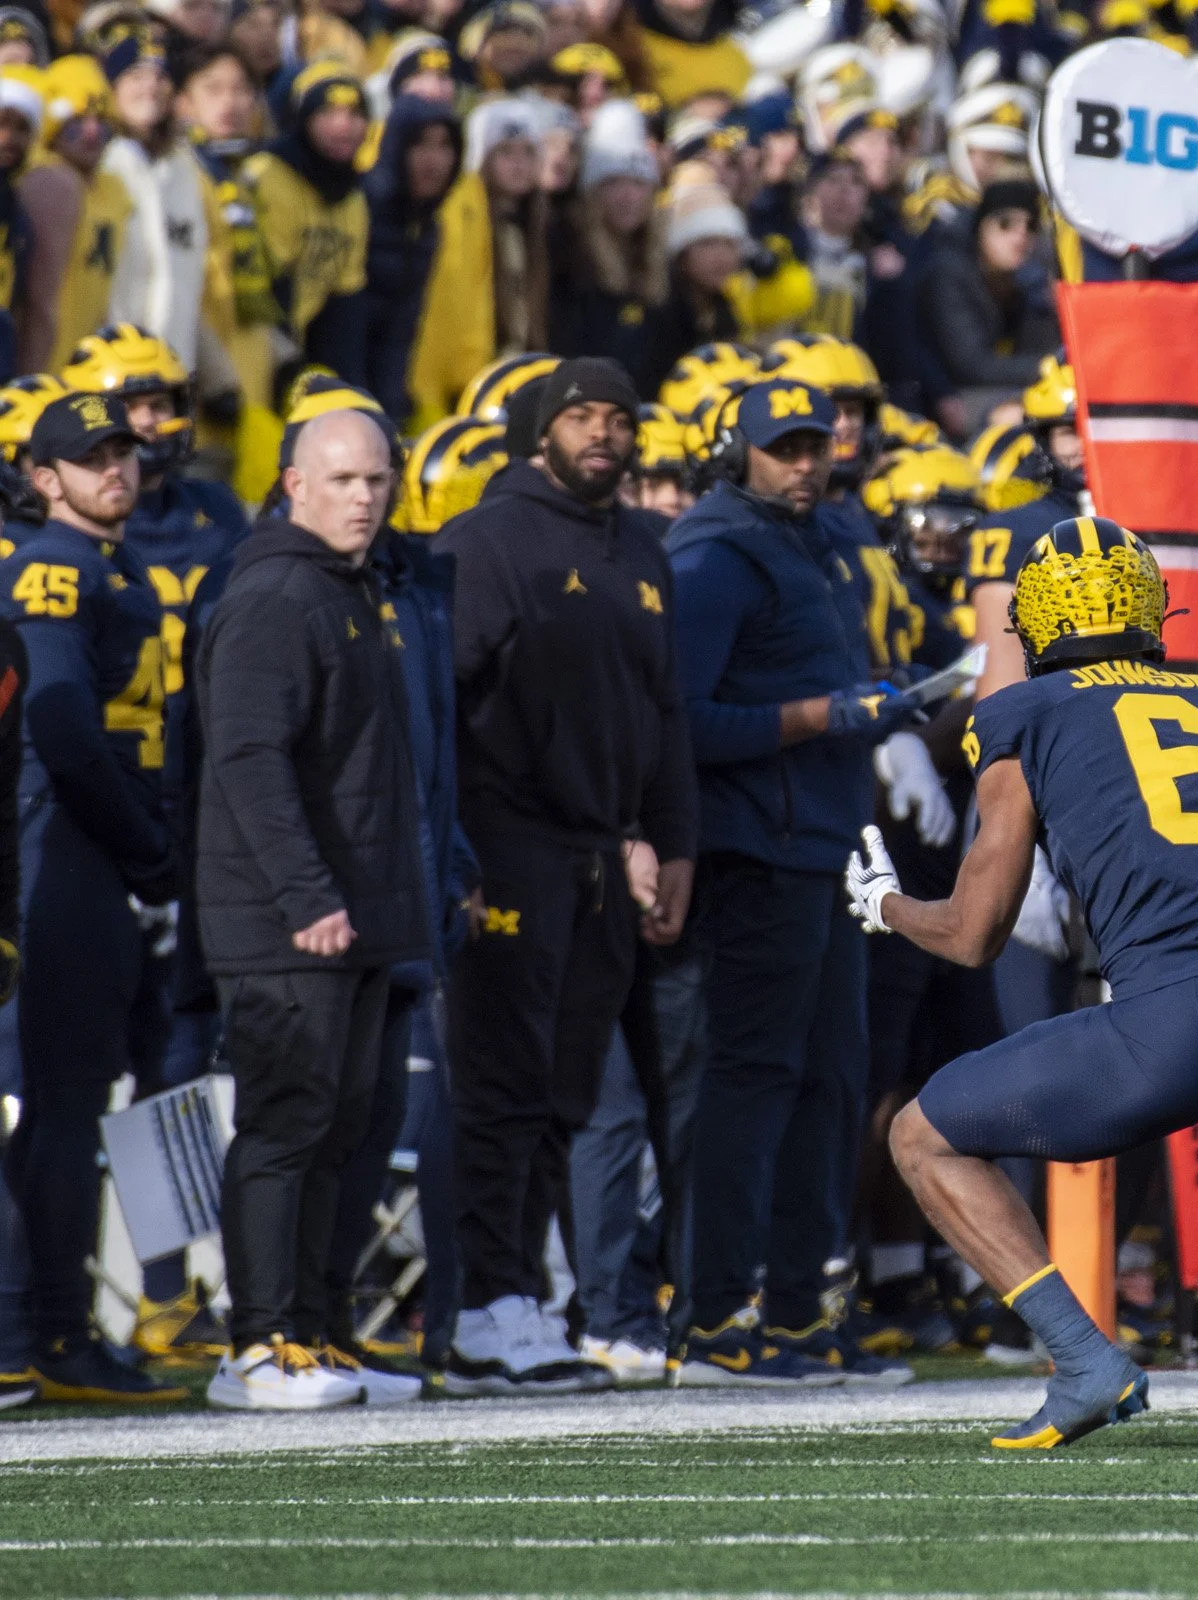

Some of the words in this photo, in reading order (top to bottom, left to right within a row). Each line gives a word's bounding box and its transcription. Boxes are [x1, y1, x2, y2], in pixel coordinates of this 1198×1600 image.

[768, 387, 813, 419] M
[969, 528, 1012, 578] 17
[12, 562, 79, 618] 45
[487, 907, 521, 936] M
